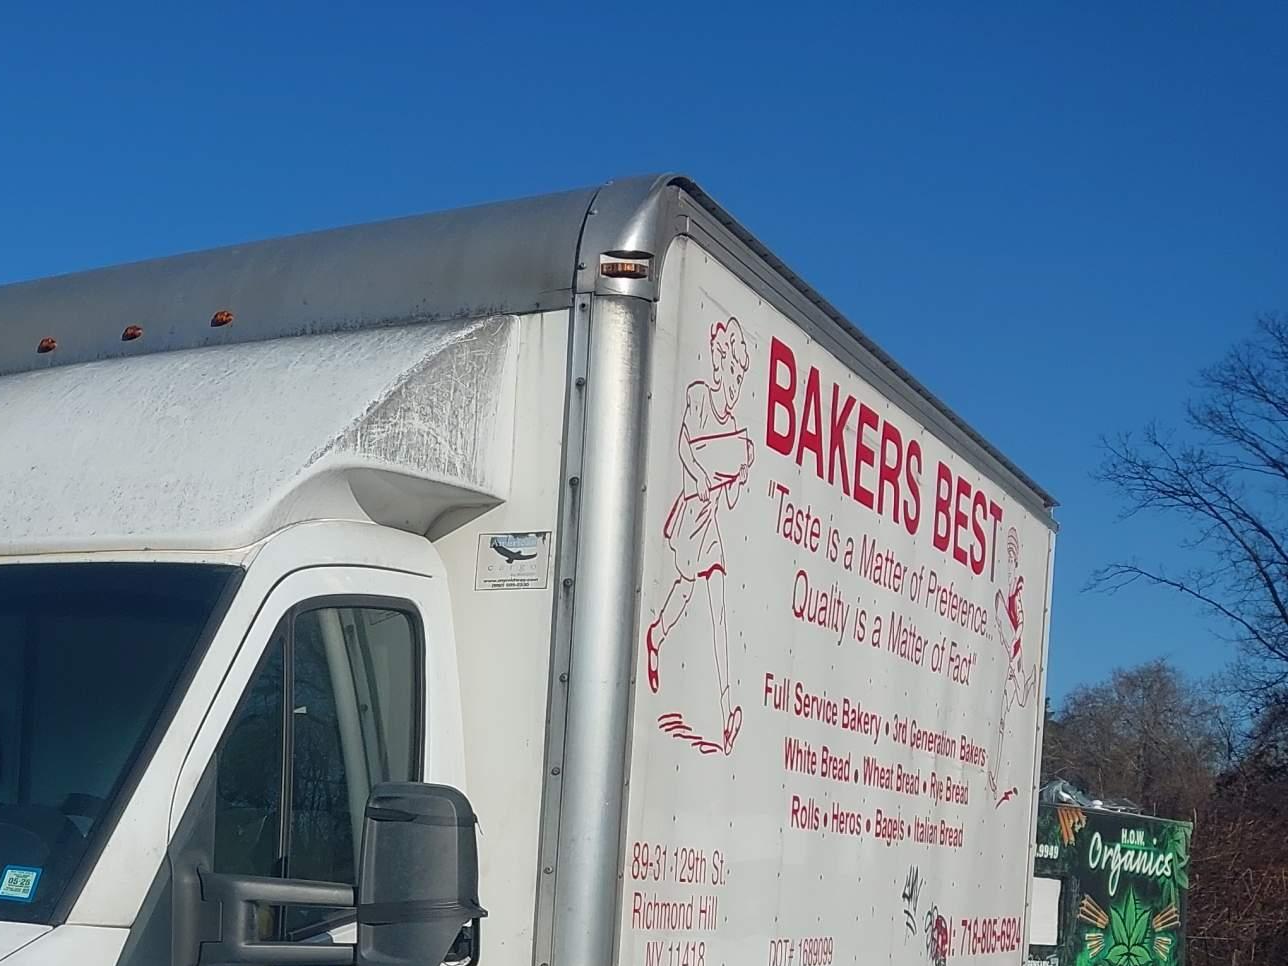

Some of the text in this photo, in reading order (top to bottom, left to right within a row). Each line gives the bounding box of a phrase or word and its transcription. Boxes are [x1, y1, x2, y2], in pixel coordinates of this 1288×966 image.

[766, 335, 1003, 582] BAKERS BEST
[767, 480, 994, 640] "Taste is a Matter of Preference...
[792, 570, 850, 646] Quality
[853, 597, 867, 642] is
[871, 614, 882, 648] a
[888, 612, 928, 666] Matter
[931, 638, 947, 674] of
[764, 672, 986, 767] Full Service Bakery 3rd Generation Bakers
[784, 736, 969, 806] White Bread Wheat Bread Rye Bread
[791, 795, 964, 848] Rolls Heros Bagels Italian Bread
[631, 842, 726, 885] 89-31 129th St.
[1088, 832, 1174, 896] Organics
[632, 892, 718, 930] Richmond Hill
[960, 917, 1022, 957] 718-805-6924
